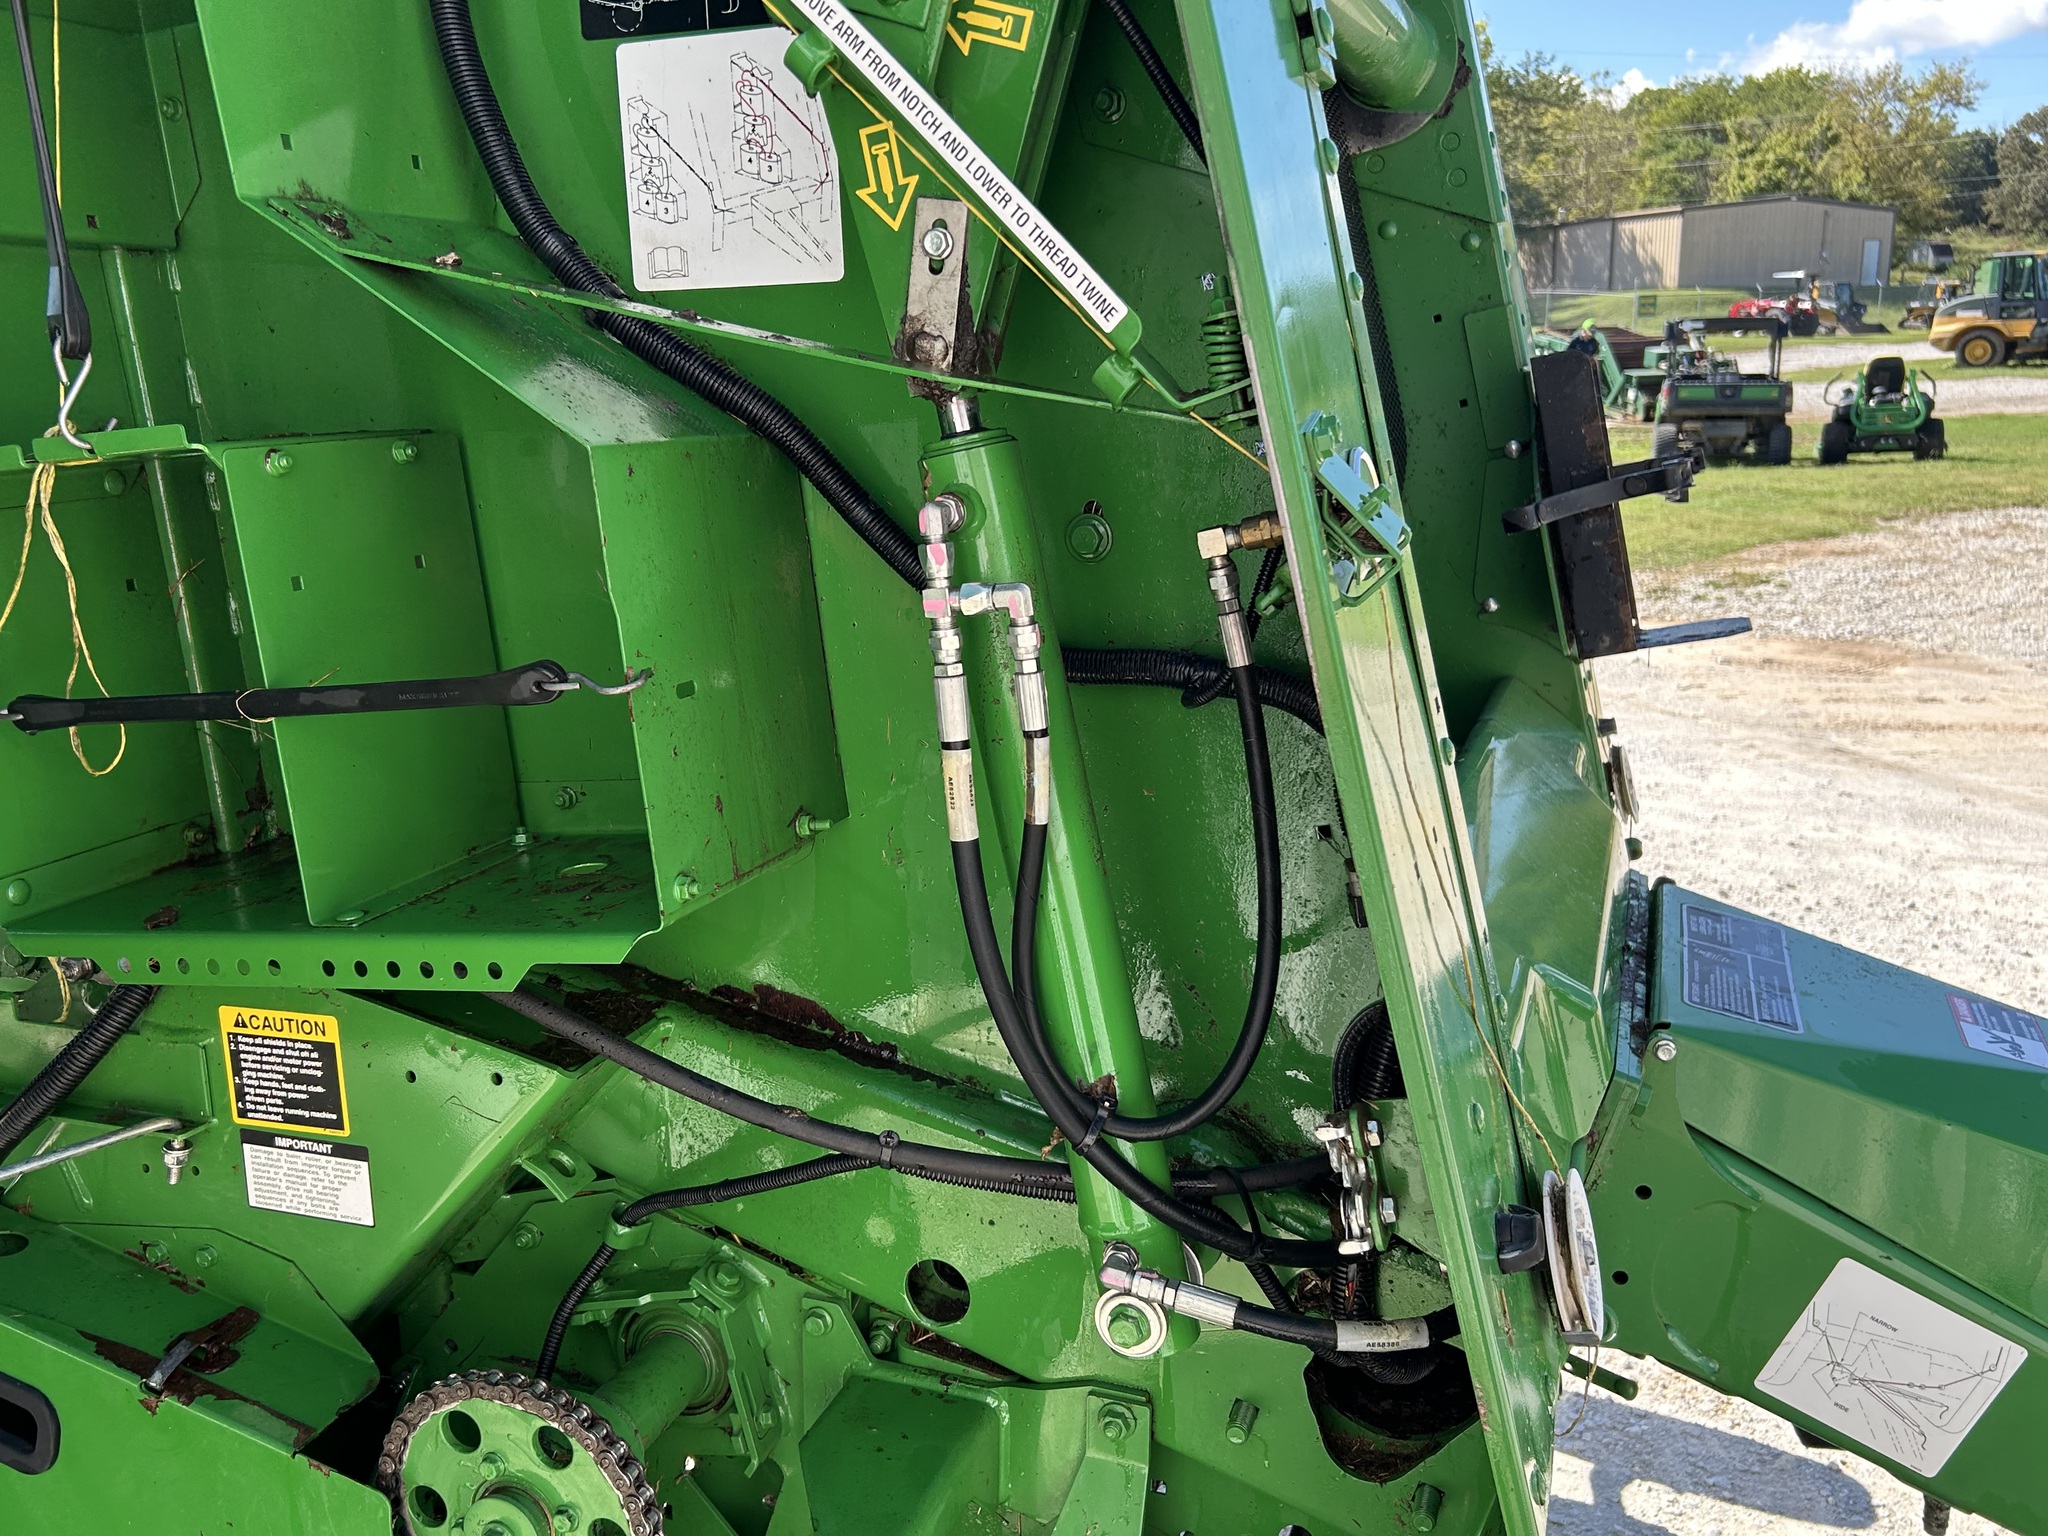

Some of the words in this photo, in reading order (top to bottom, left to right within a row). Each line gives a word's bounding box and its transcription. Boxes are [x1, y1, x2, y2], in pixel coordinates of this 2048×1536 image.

[751, 124, 756, 133] 2
[803, 0, 836, 25] OVE
[832, 20, 866, 54] ARM
[861, 47, 902, 92] FROM
[897, 85, 943, 135] NOTCH
[938, 131, 969, 162] AND
[965, 157, 1013, 210] LOWER
[1010, 203, 1030, 227] TO
[1028, 222, 1078, 279] THREAD
[1076, 273, 1118, 322] TWINE
[647, 167, 653, 175] 2
[249, 1014, 326, 1036] CAUTION
[238, 1035, 253, 1044] Keep
[263, 1038, 286, 1046] shields
[295, 1041, 313, 1050] place.
[239, 1044, 271, 1054] Disengage
[286, 1048, 299, 1056] shut
[240, 1052, 261, 1061] engine
[262, 1054, 282, 1063] and/or
[283, 1057, 301, 1065] motor
[303, 1059, 322, 1068] power
[241, 1060, 261, 1069] before
[262, 1063, 290, 1073] servicing
[300, 1067, 323, 1077] unclog-
[242, 1069, 257, 1078] ging
[258, 1070, 285, 1080] machine.
[243, 1077, 259, 1086] Keep
[260, 1079, 281, 1088] hands,
[308, 1084, 326, 1093] cloth-
[244, 1085, 254, 1094] ing
[256, 1088, 271, 1096] away
[288, 1091, 309, 1100] power-
[245, 1094, 264, 1102] driven
[266, 1096, 284, 1106] parts.
[247, 1111, 283, 1121] unattended.
[268, 1105, 284, 1113] leave
[285, 1107, 309, 1117] running
[311, 1110, 337, 1119] machine
[274, 1136, 333, 1154] IMPORTANT
[249, 1146, 273, 1156] Damage
[334, 1160, 361, 1168] bearings
[251, 1166, 270, 1174] failure
[251, 1160, 283, 1169] installation
[333, 1173, 356, 1181] prevent
[301, 1161, 328, 1171] improper
[331, 1166, 351, 1175] torque
[285, 1178, 307, 1186] manual
[254, 1193, 286, 1203] sequences
[316, 1190, 339, 1199] bearing
[255, 1199, 282, 1208] loosened
[304, 1207, 337, 1218] performing
[1870, 1315, 1898, 1332] NARROW
[1833, 1401, 1849, 1412] WIDE
